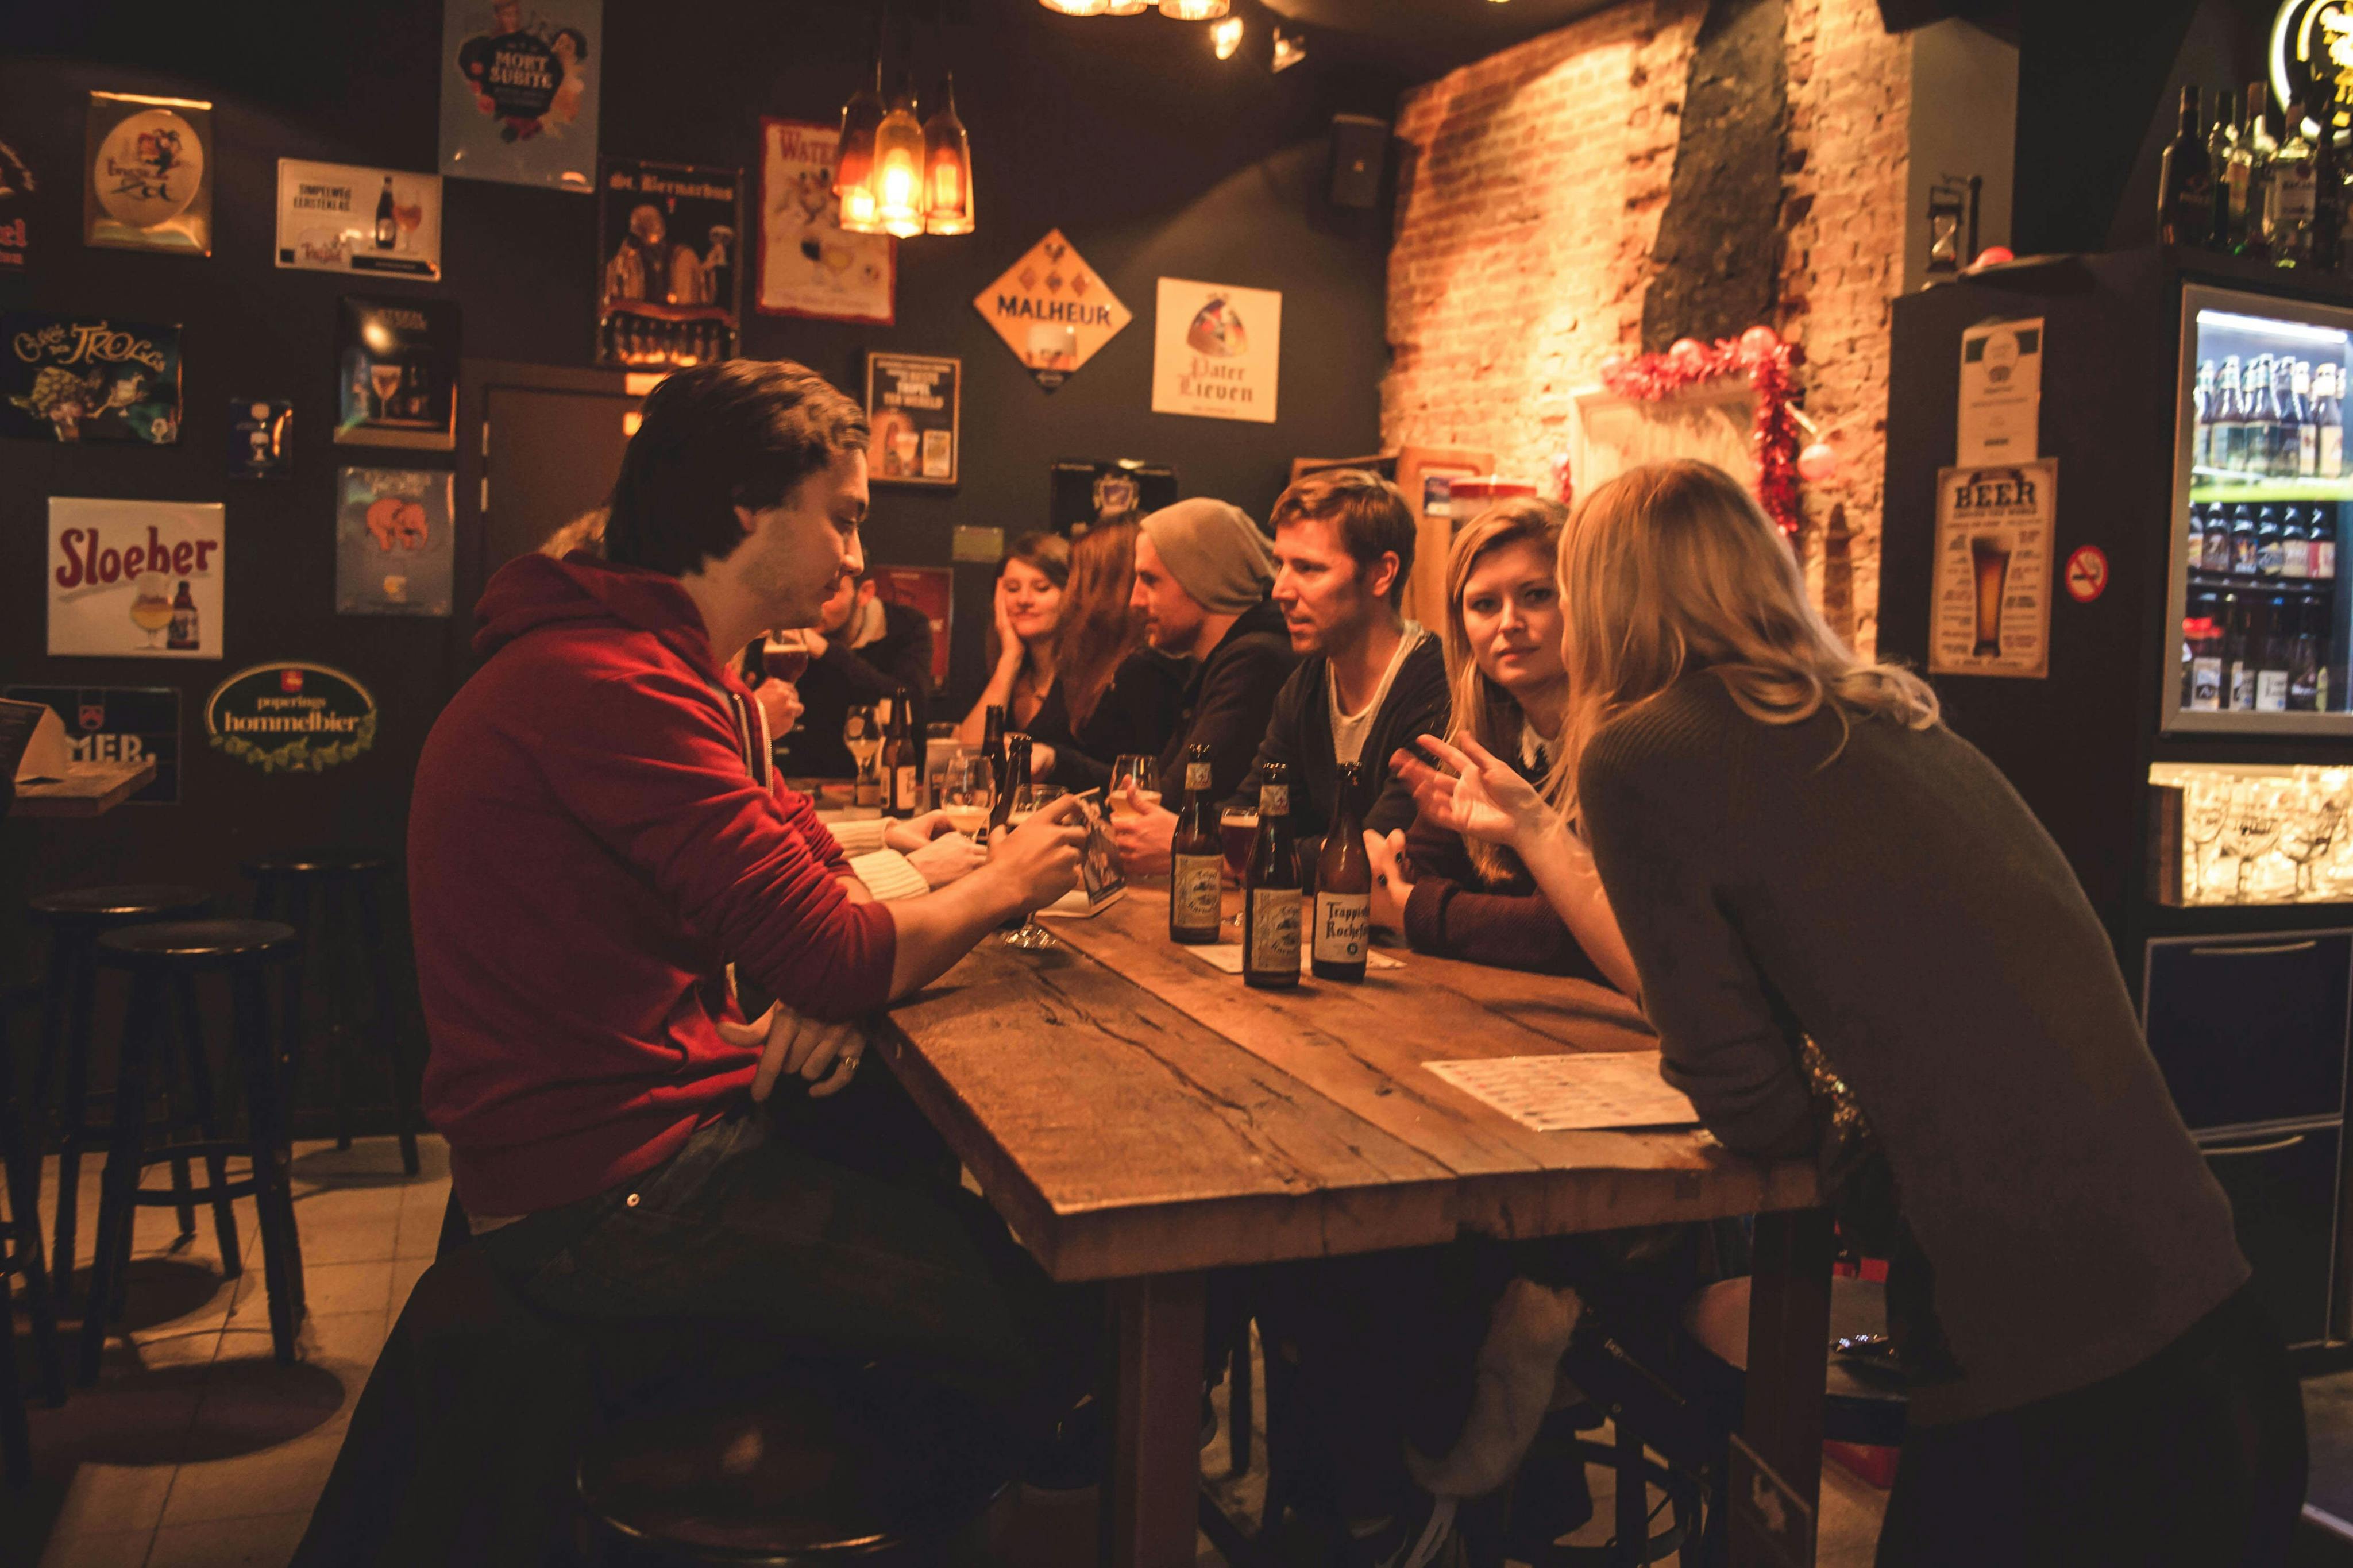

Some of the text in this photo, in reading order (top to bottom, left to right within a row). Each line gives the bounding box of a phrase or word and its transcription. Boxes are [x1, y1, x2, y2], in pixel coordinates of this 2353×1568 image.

[494, 51, 550, 72] MORT
[489, 65, 553, 89] SUBITE
[997, 293, 1111, 327] MALHEUR
[1178, 374, 1253, 403] Lieven
[1955, 481, 2035, 509] BEER
[56, 524, 218, 589] Sloeber
[225, 711, 360, 732] hommelbier
